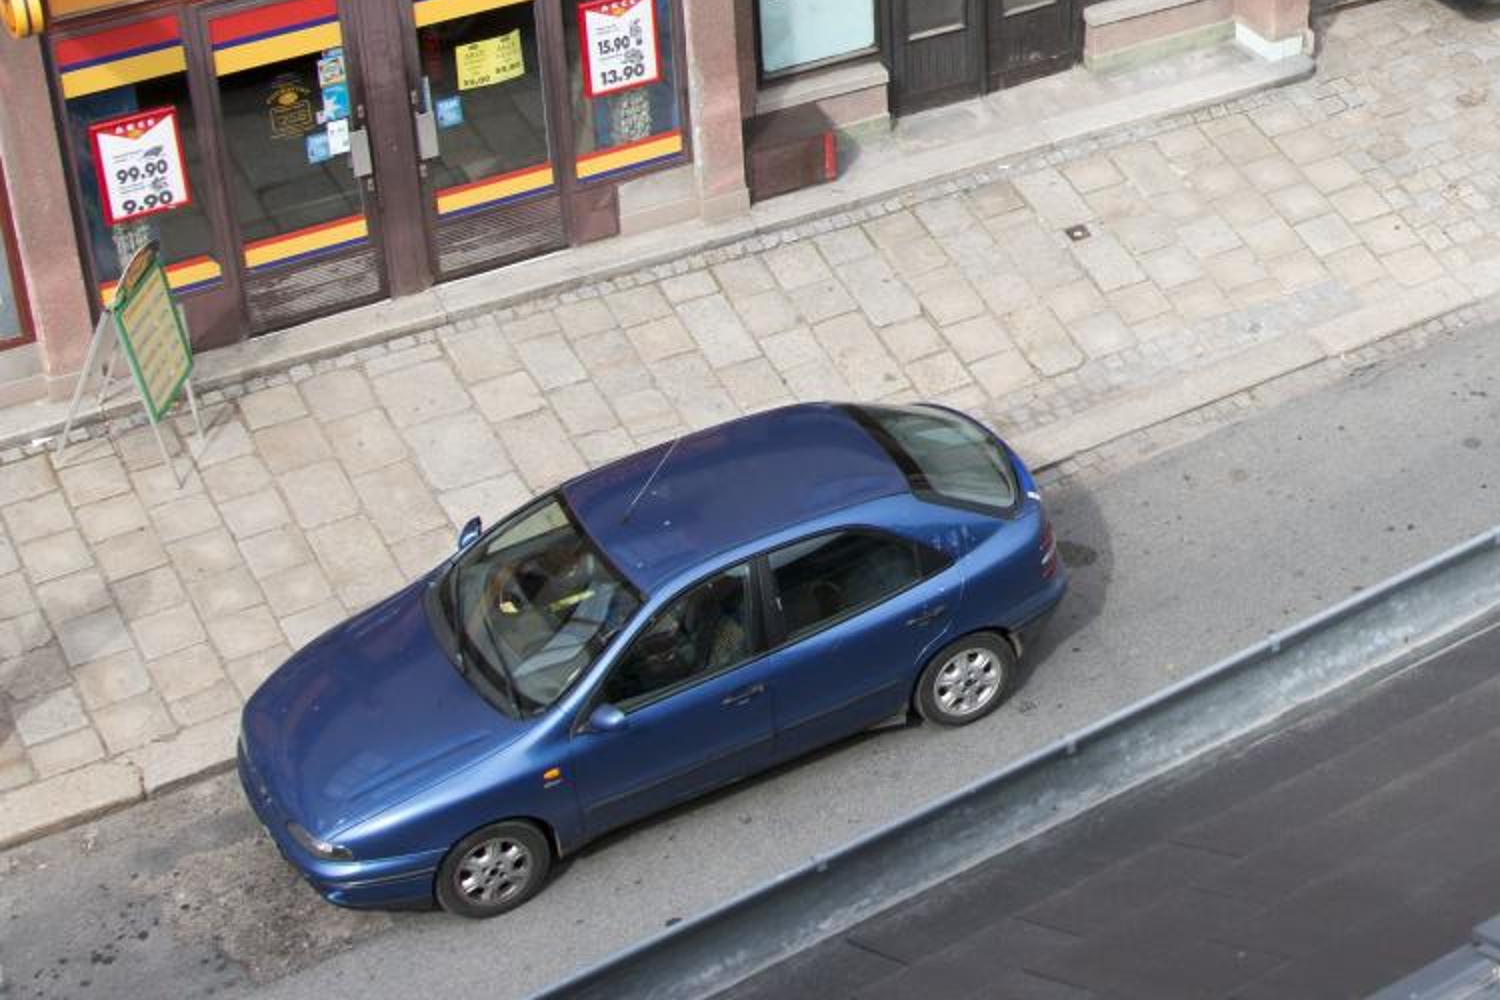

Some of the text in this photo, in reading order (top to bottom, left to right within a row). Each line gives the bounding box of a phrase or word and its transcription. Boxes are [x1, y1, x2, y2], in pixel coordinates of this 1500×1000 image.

[597, 35, 631, 55] 15.90
[600, 62, 645, 85] 13.90
[116, 159, 169, 184] 99.90
[122, 190, 173, 214] 9.90
